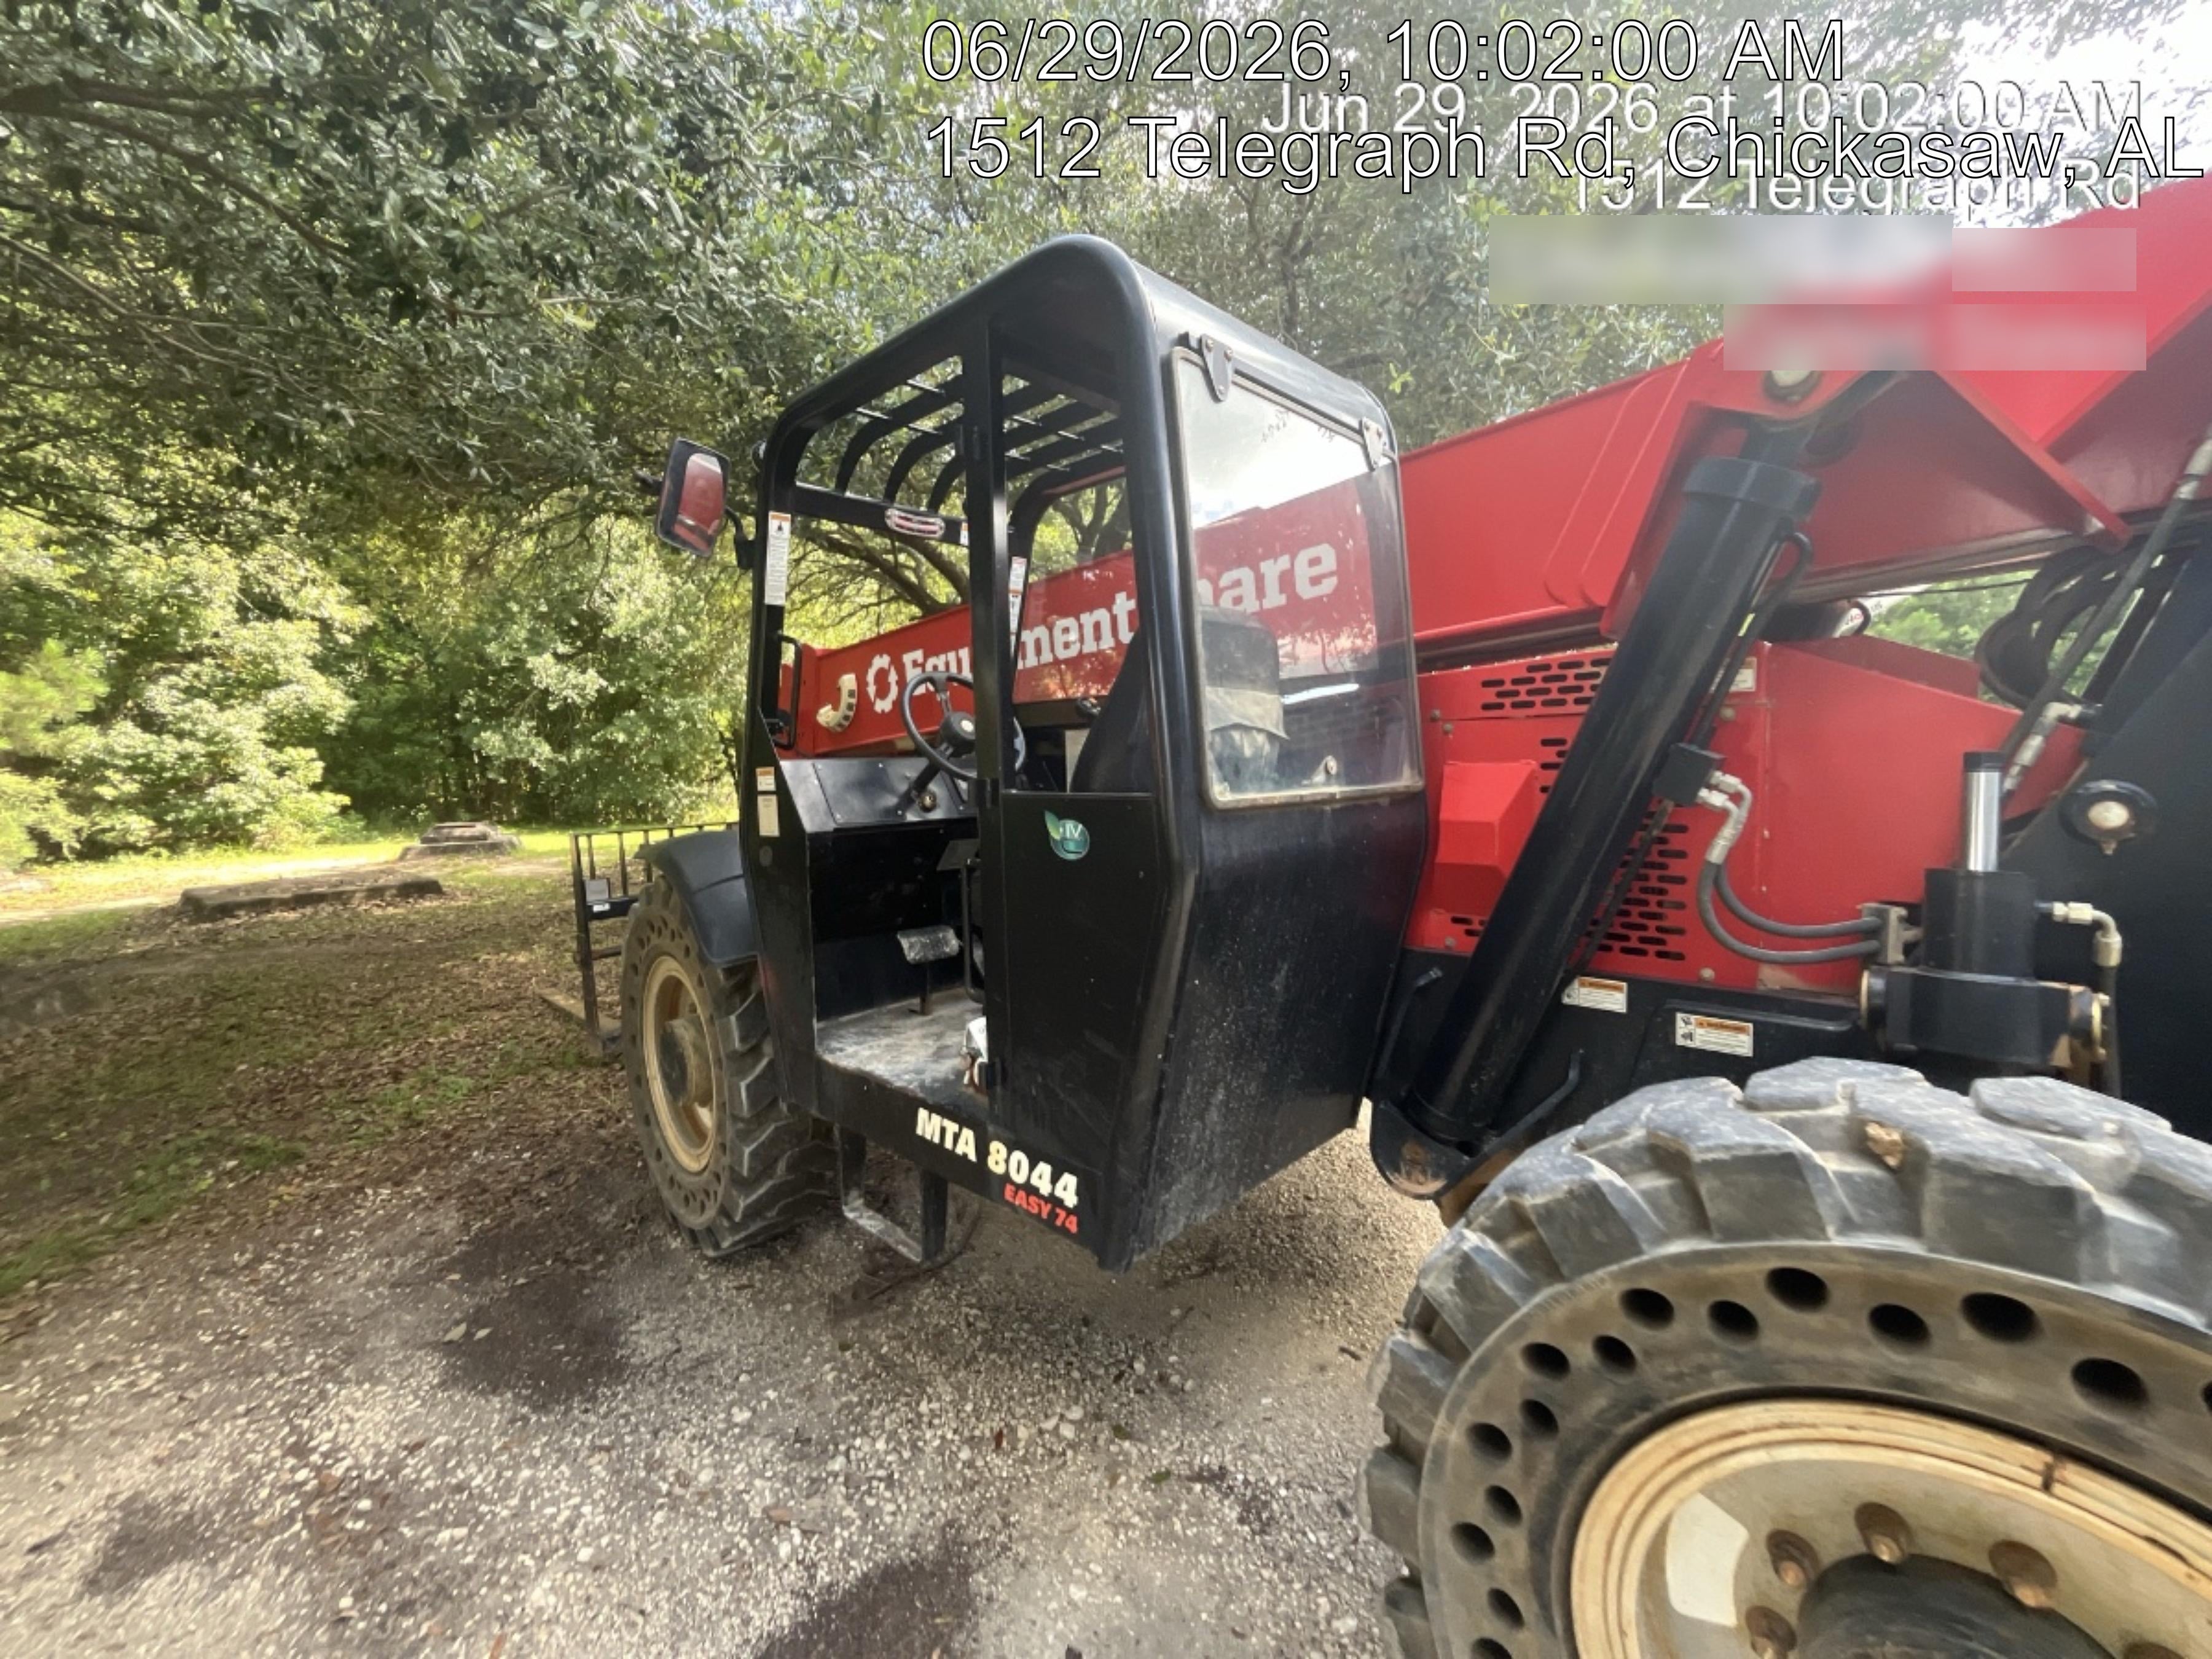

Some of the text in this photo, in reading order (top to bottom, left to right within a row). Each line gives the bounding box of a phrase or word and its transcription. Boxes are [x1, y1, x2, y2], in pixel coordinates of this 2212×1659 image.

[916, 1107, 1078, 1209] MTA 8044
[1004, 1183, 1078, 1234] EASY 74
